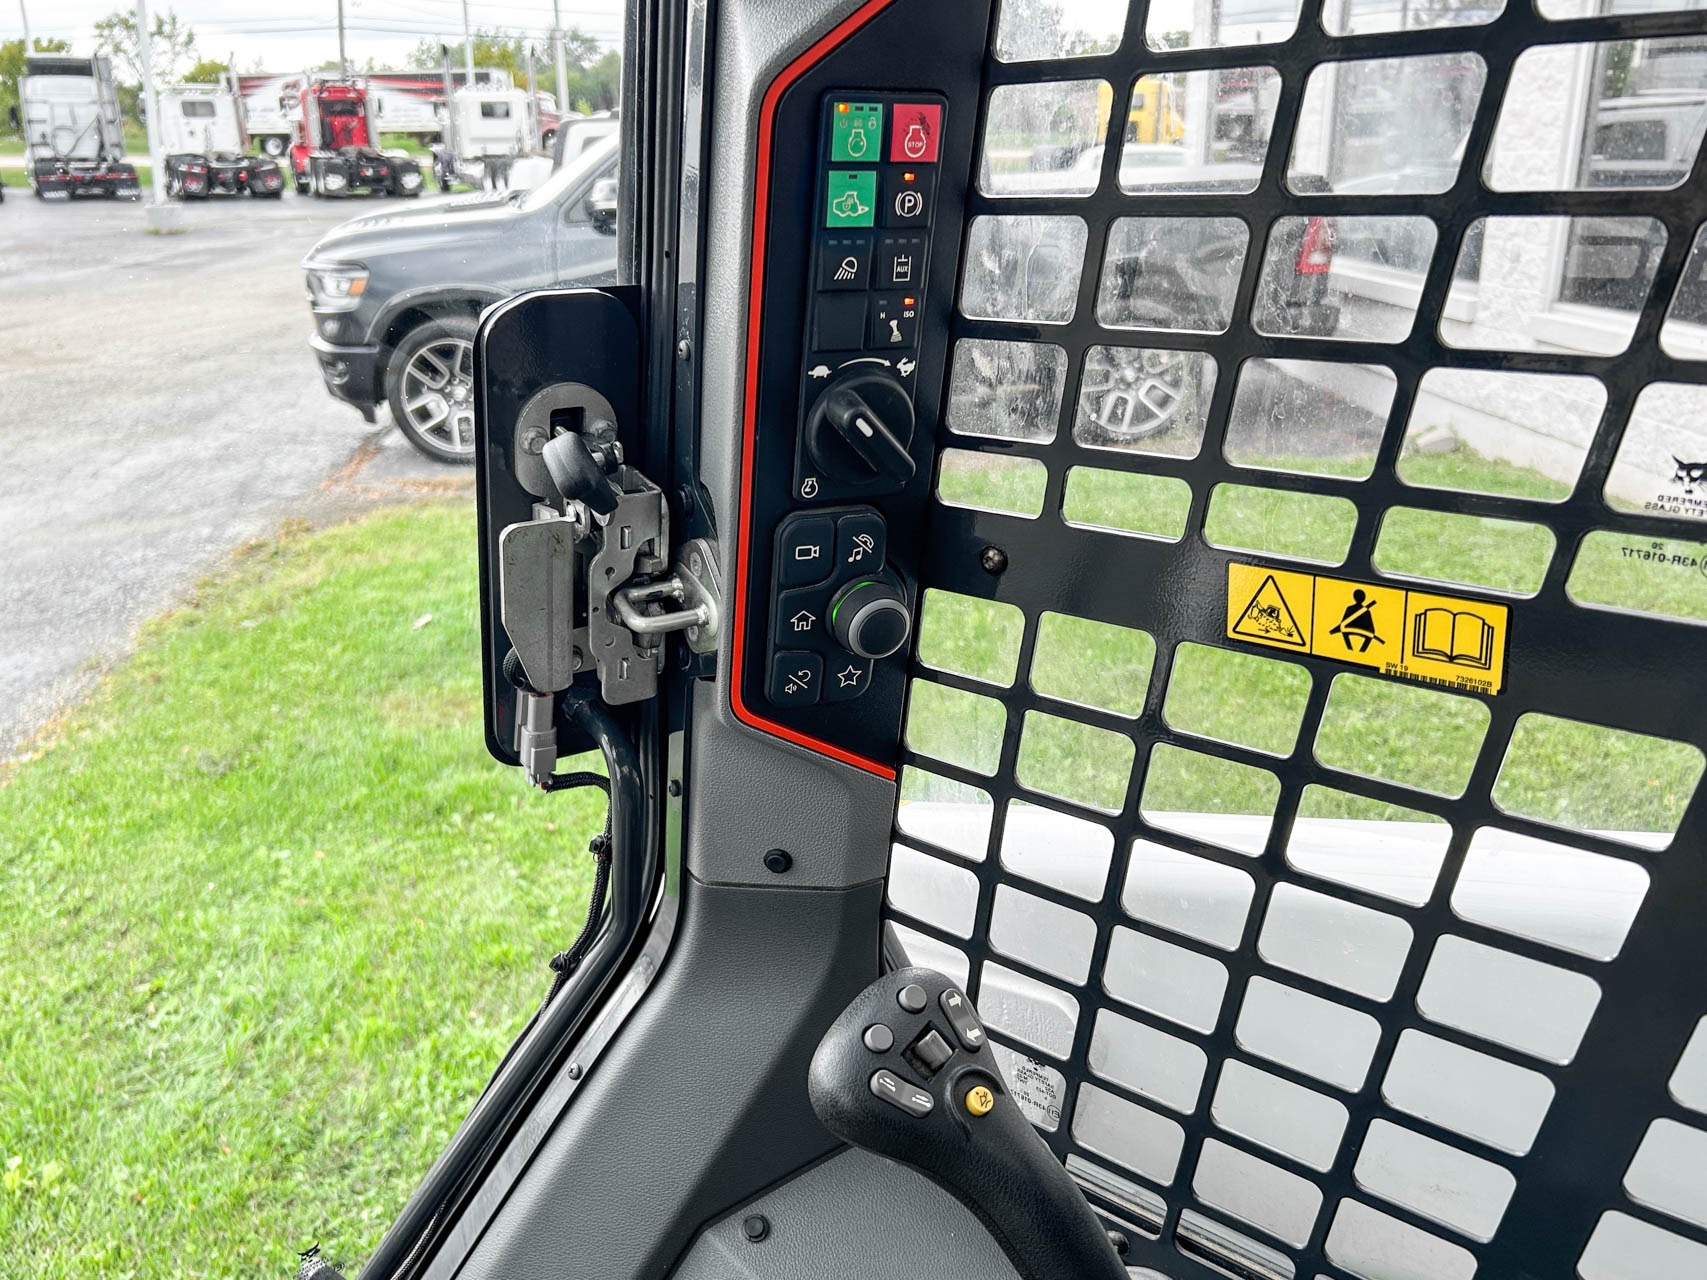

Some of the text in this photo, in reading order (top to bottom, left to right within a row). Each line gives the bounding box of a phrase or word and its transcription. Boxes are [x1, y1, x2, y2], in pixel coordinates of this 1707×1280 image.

[908, 141, 923, 149] STOP
[904, 196, 915, 213] P
[896, 265, 909, 273] AUX
